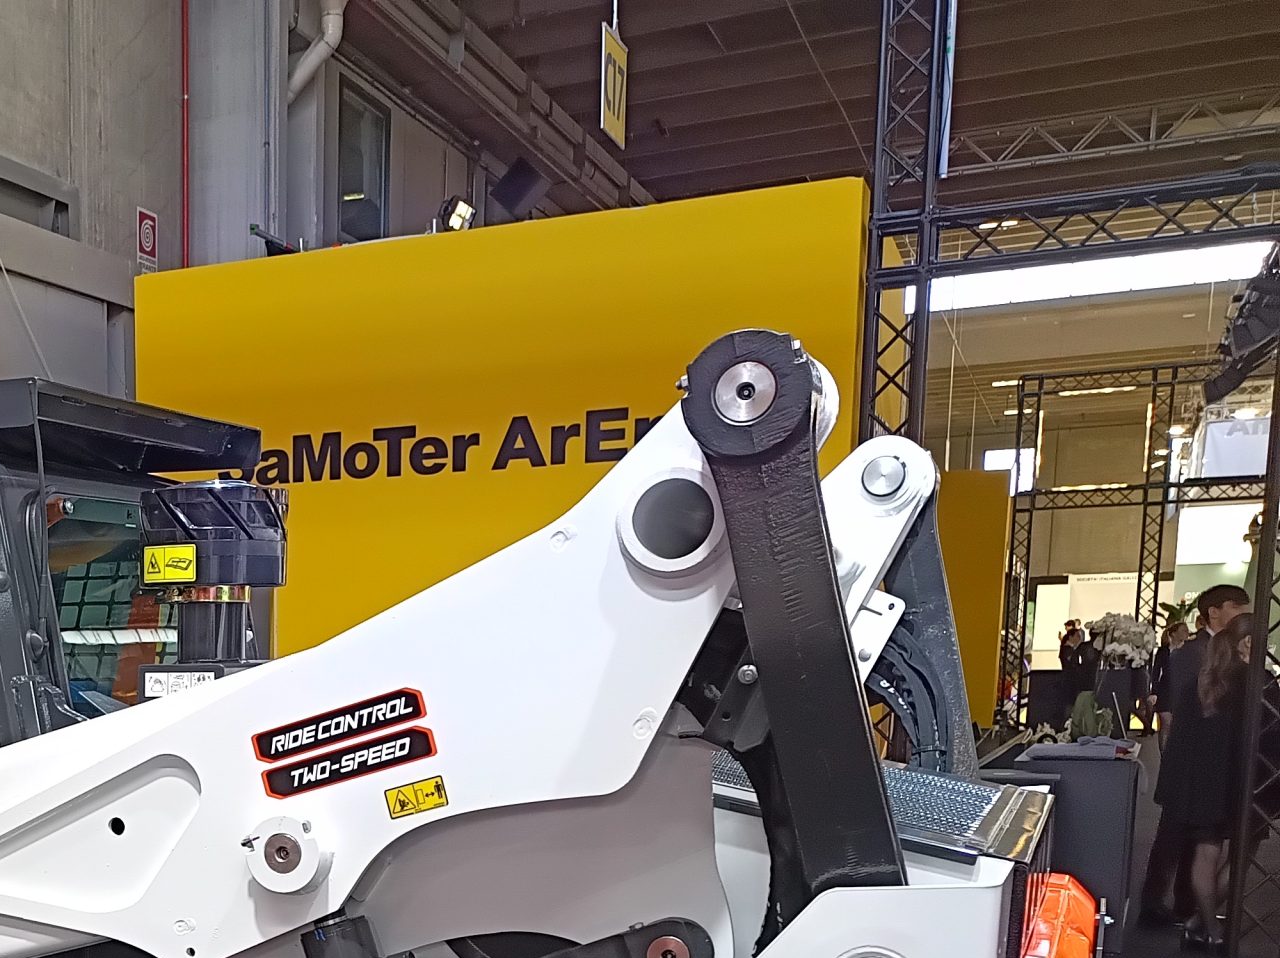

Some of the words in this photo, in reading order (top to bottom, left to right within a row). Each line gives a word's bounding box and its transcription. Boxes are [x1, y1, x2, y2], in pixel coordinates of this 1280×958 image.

[605, 52, 625, 121] C17
[218, 425, 480, 486] aMoTer
[271, 724, 317, 755] RIDE
[317, 697, 414, 740] CONTROL
[290, 737, 411, 787] TWO-SPEED
